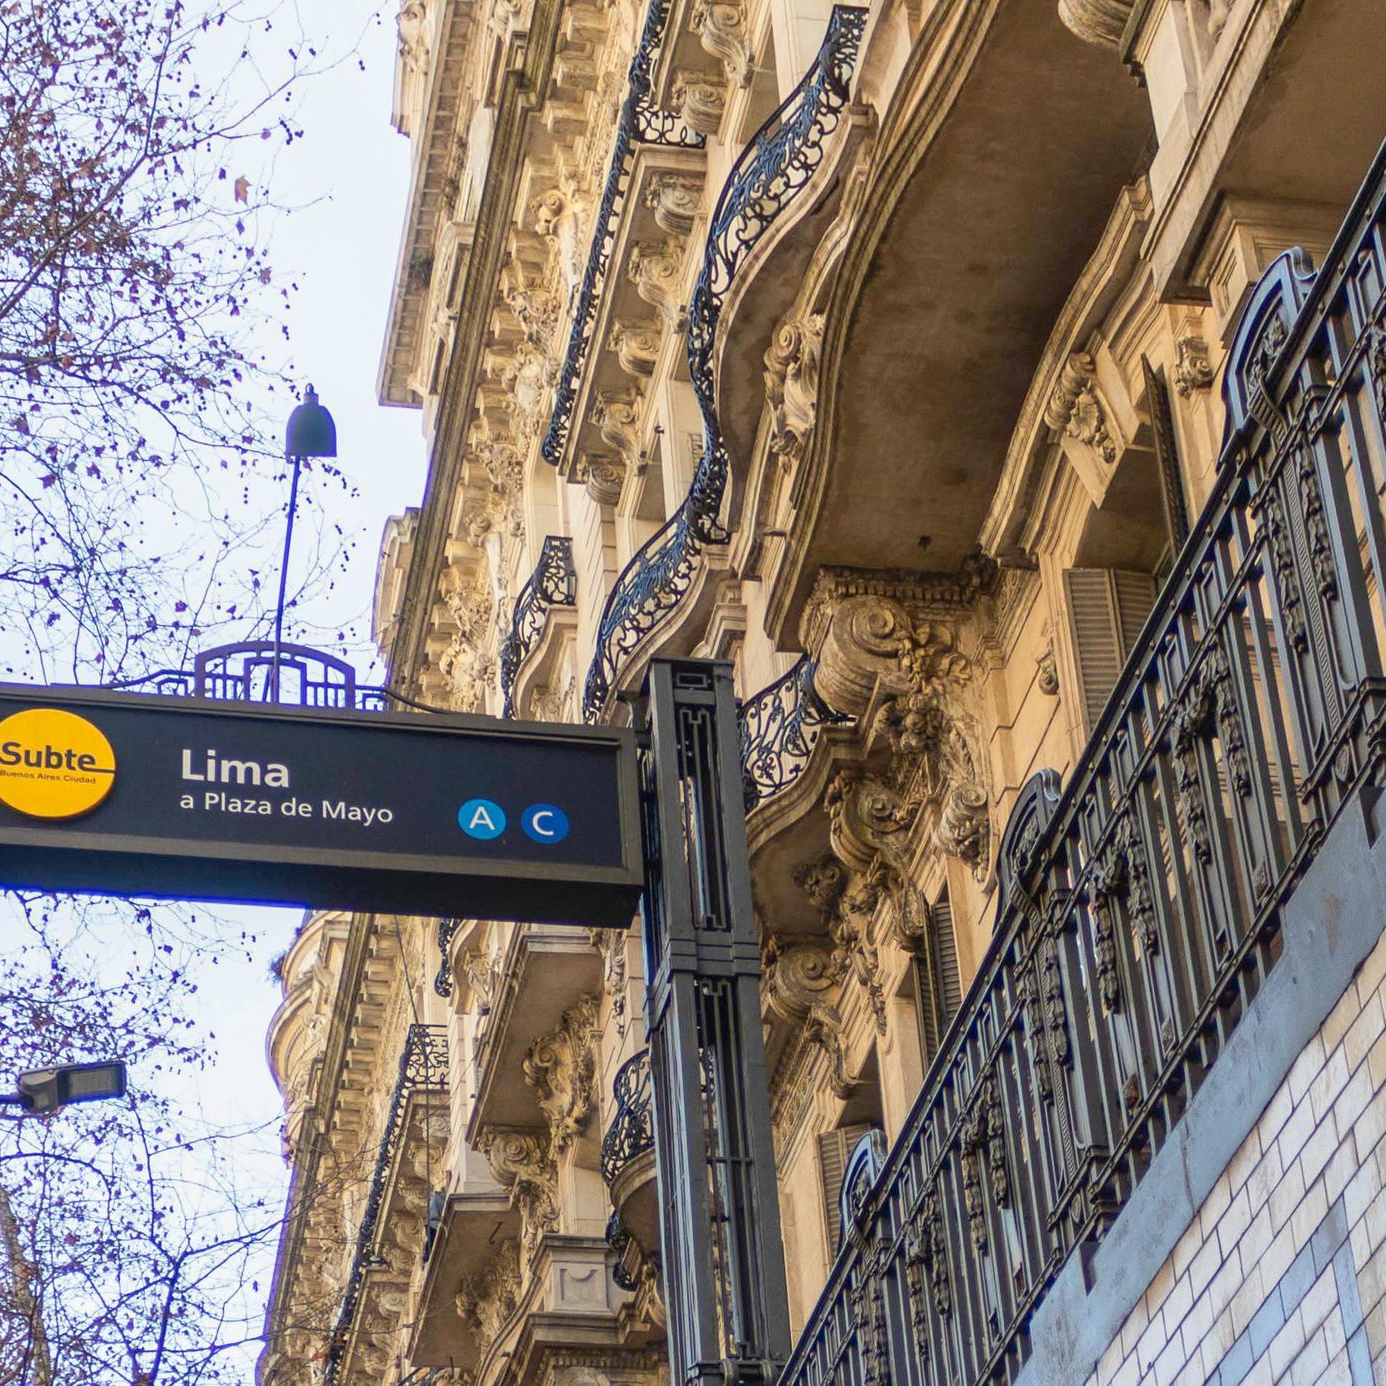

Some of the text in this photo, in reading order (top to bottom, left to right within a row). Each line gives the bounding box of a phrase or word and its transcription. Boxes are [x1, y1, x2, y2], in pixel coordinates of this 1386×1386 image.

[0, 741, 97, 773] Subte
[181, 748, 290, 789] Lima
[0, 769, 96, 785] Buenos Aires Ciudad
[179, 791, 394, 827] a Plaza de Mayo
[468, 805, 555, 837] A C
